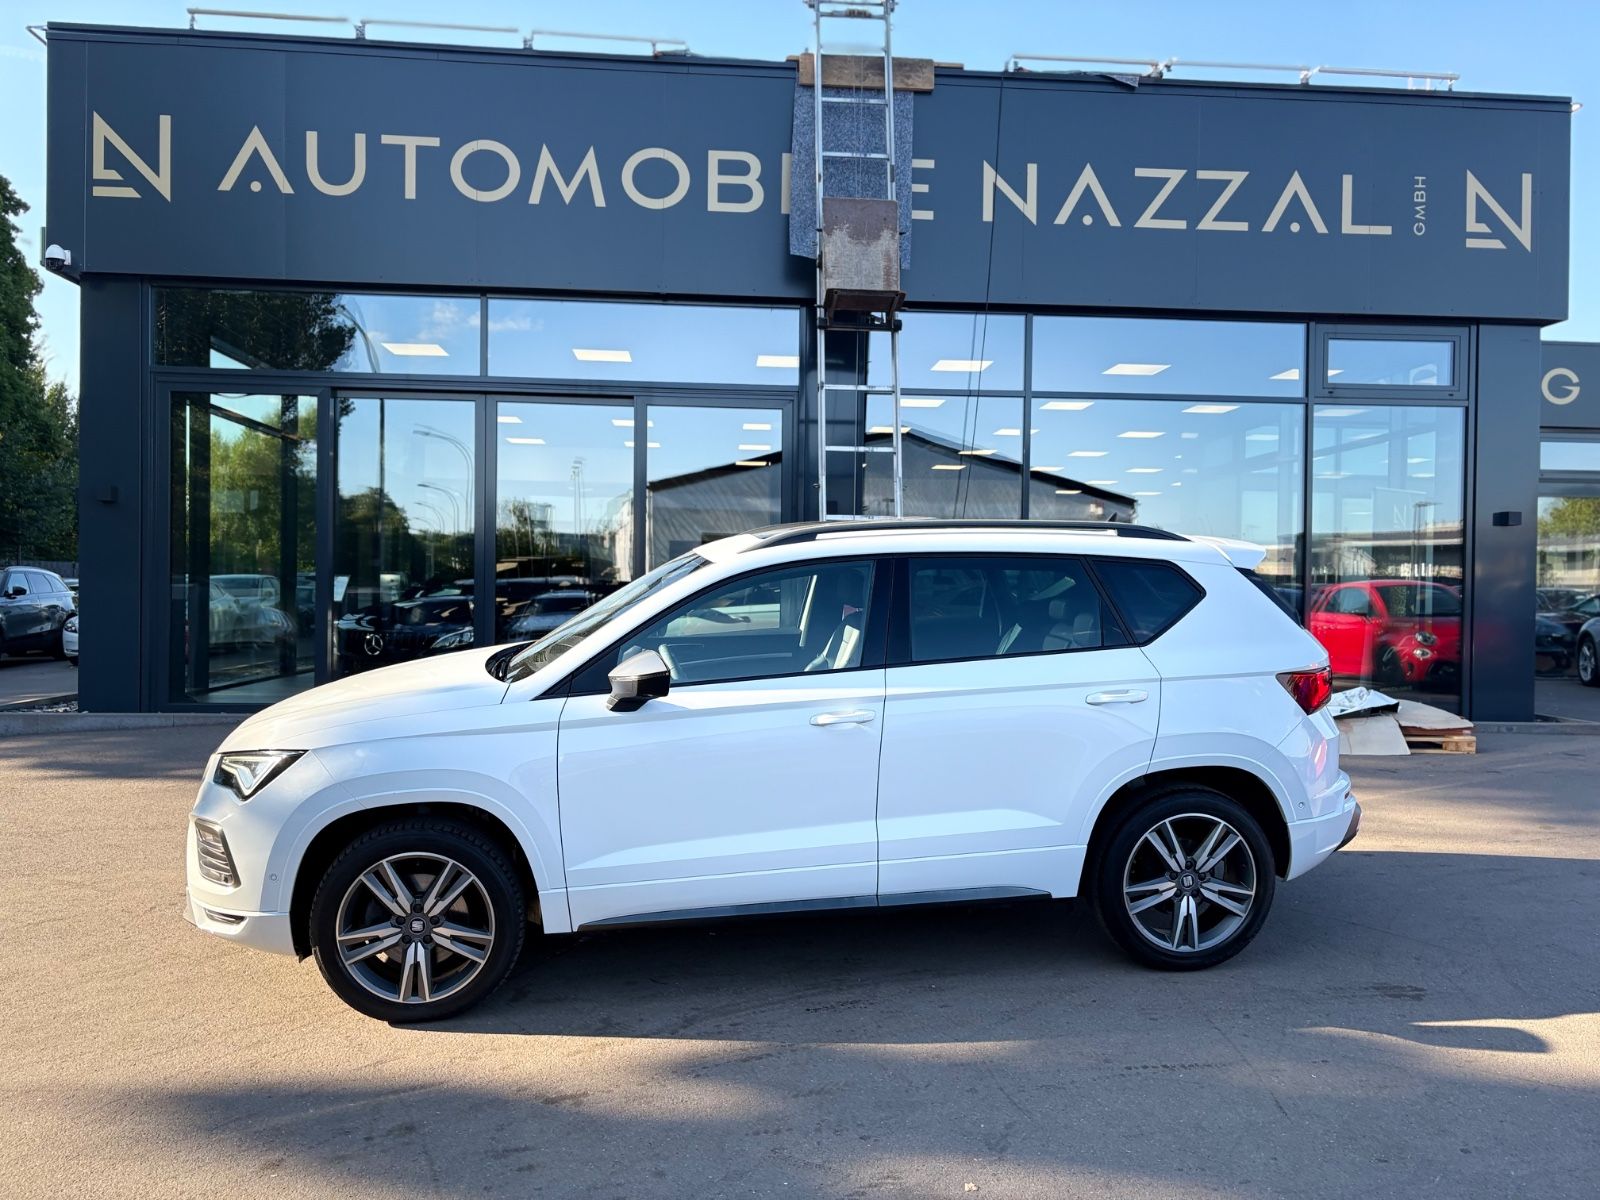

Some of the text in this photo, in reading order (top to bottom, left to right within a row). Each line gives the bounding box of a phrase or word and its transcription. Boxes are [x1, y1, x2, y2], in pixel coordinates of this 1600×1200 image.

[217, 125, 1393, 236] AUTOMOBIE NAZZAL
[1413, 176, 1427, 236] GMBH
[1541, 367, 1581, 406] G
